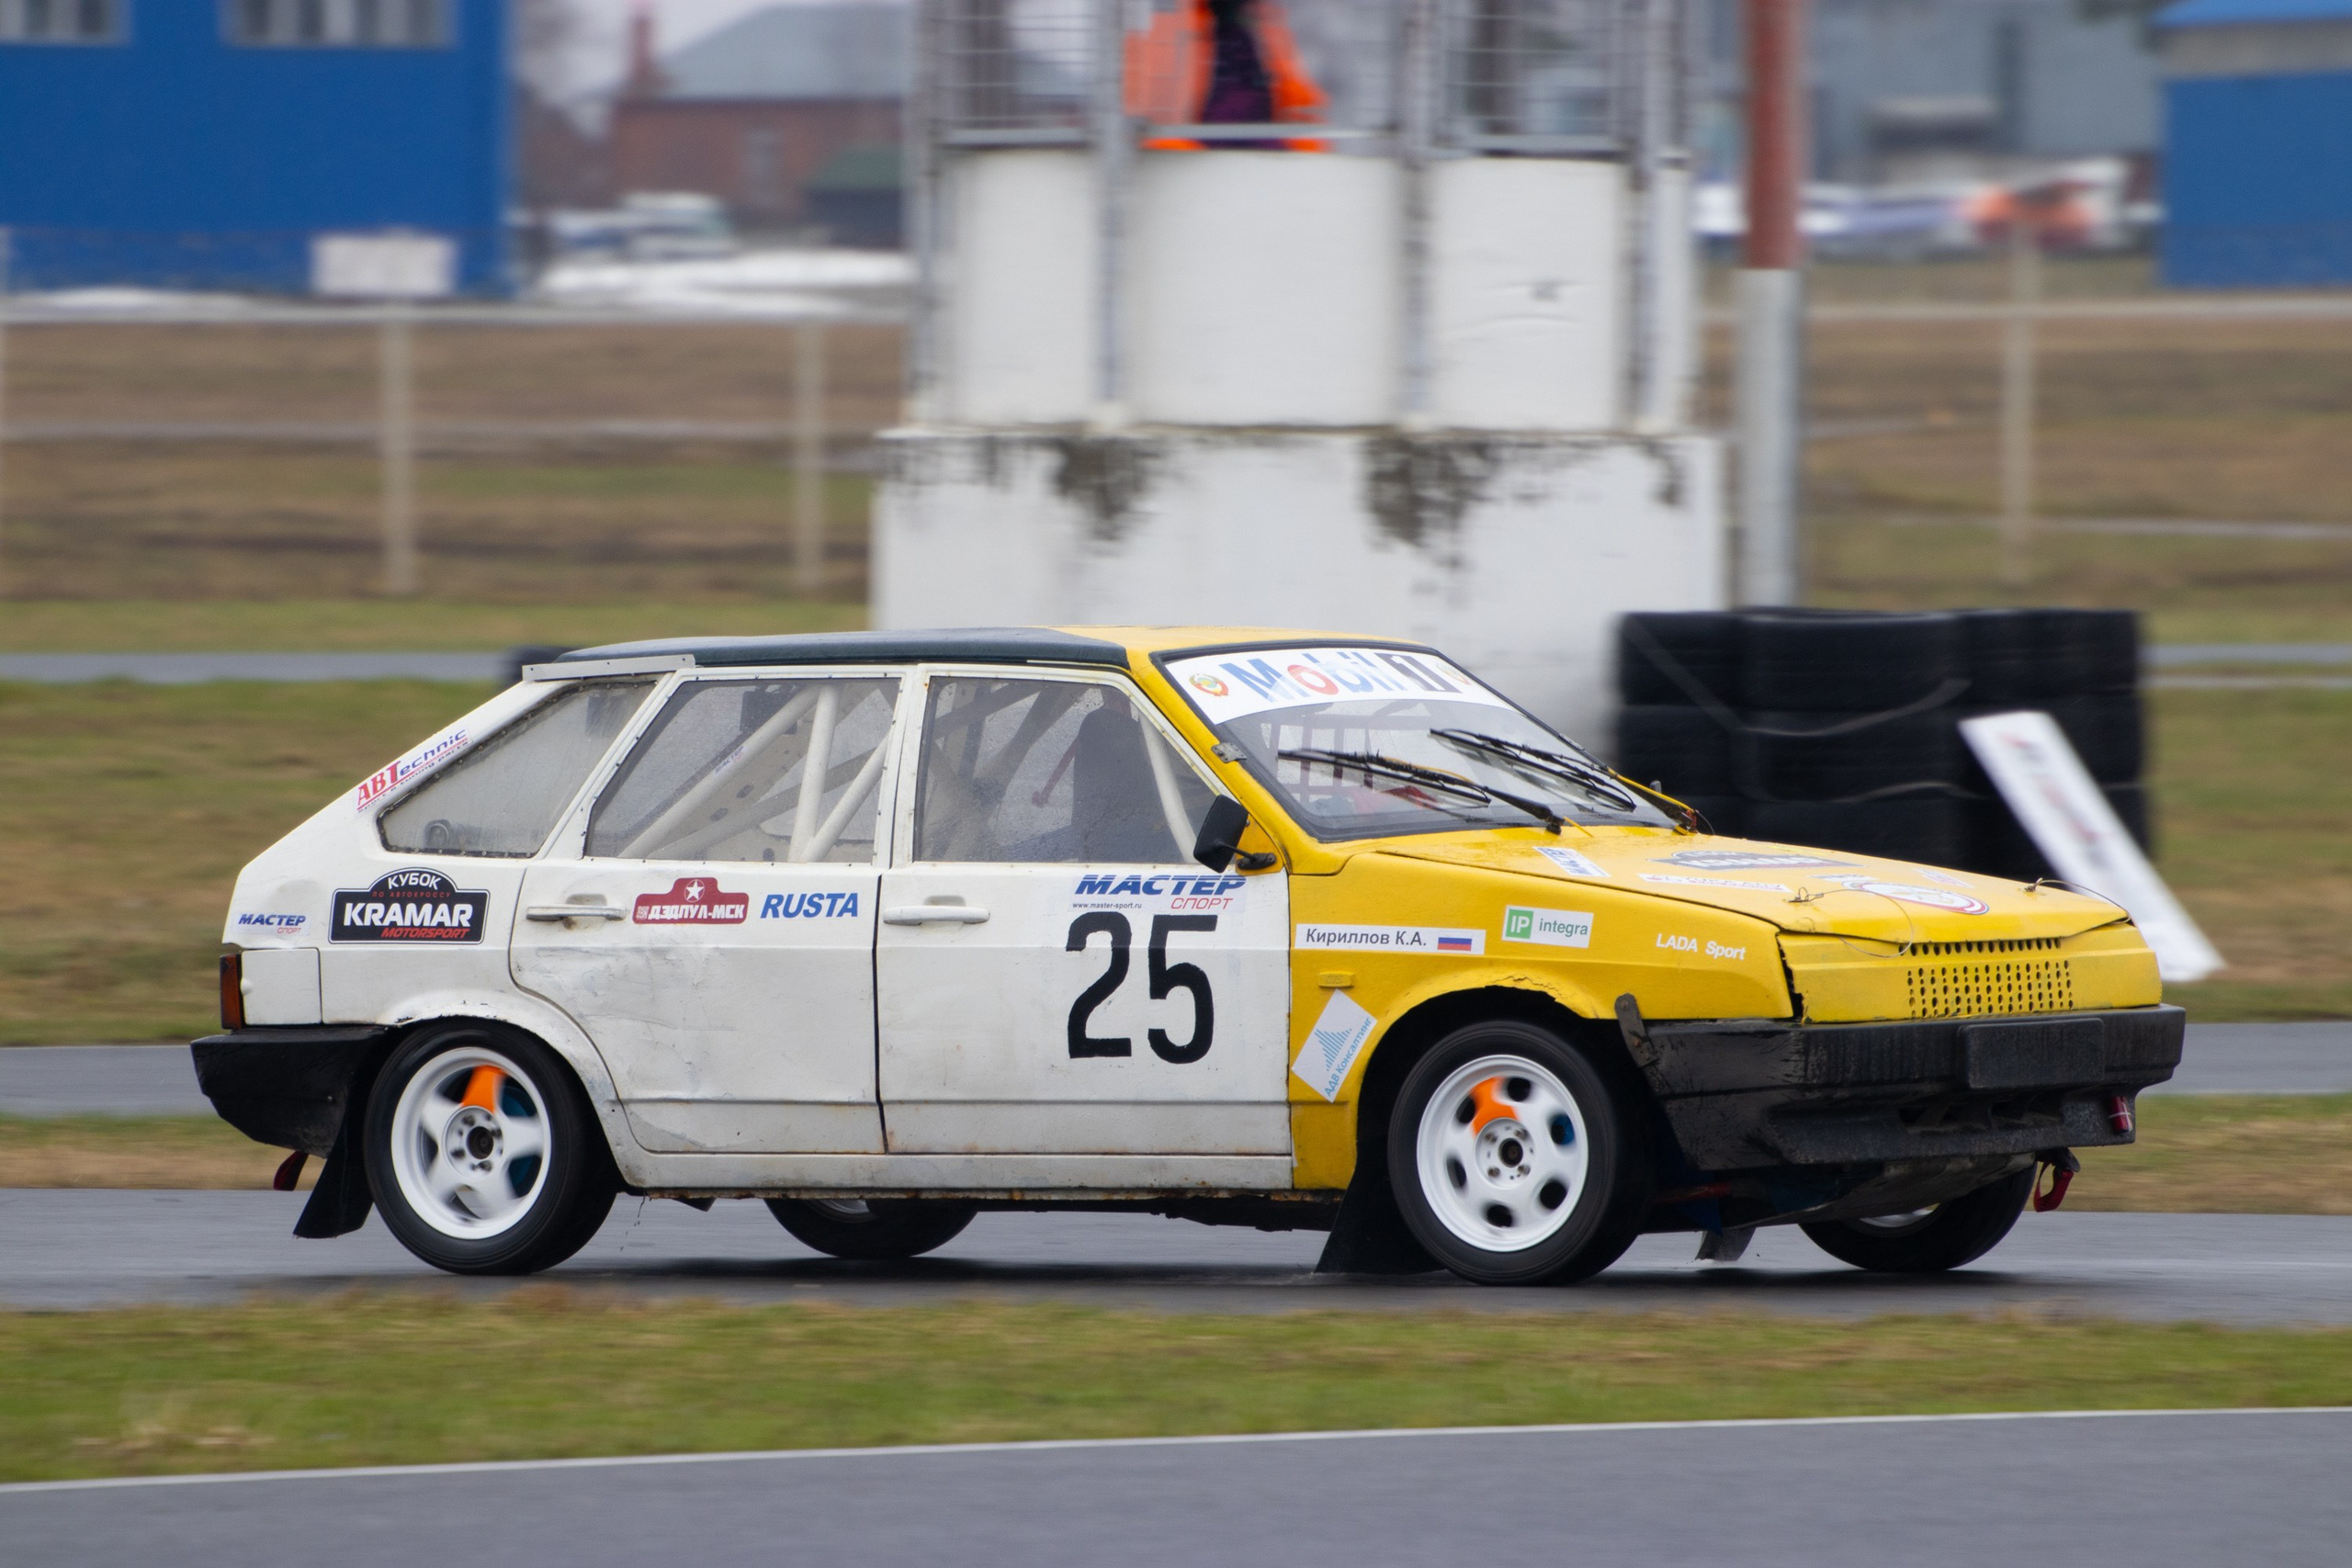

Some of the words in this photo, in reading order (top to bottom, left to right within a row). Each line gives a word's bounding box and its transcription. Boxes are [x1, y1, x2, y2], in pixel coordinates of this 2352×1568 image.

[388, 873, 441, 890] КУБОК
[1075, 874, 1247, 896] МАСТЕР
[648, 904, 745, 919] ДЭДПУЛ-МСК
[760, 893, 858, 919] RUSTA
[1170, 897, 1234, 910] СПОРТ
[238, 914, 306, 926] МАСТЕР
[344, 903, 473, 927] KRAMAR
[1510, 915, 1530, 933] IP
[1539, 919, 1589, 937] integra
[381, 928, 469, 939] MOTORSPORT
[1306, 928, 1390, 945] Кириллов
[1395, 931, 1427, 946] К.А.
[1656, 932, 1699, 953] LADA
[1705, 941, 1747, 961] Sport
[1066, 911, 1218, 1064] 25
[1325, 1074, 1341, 1097] АДВ
[1336, 1017, 1373, 1076] Консалтинг
